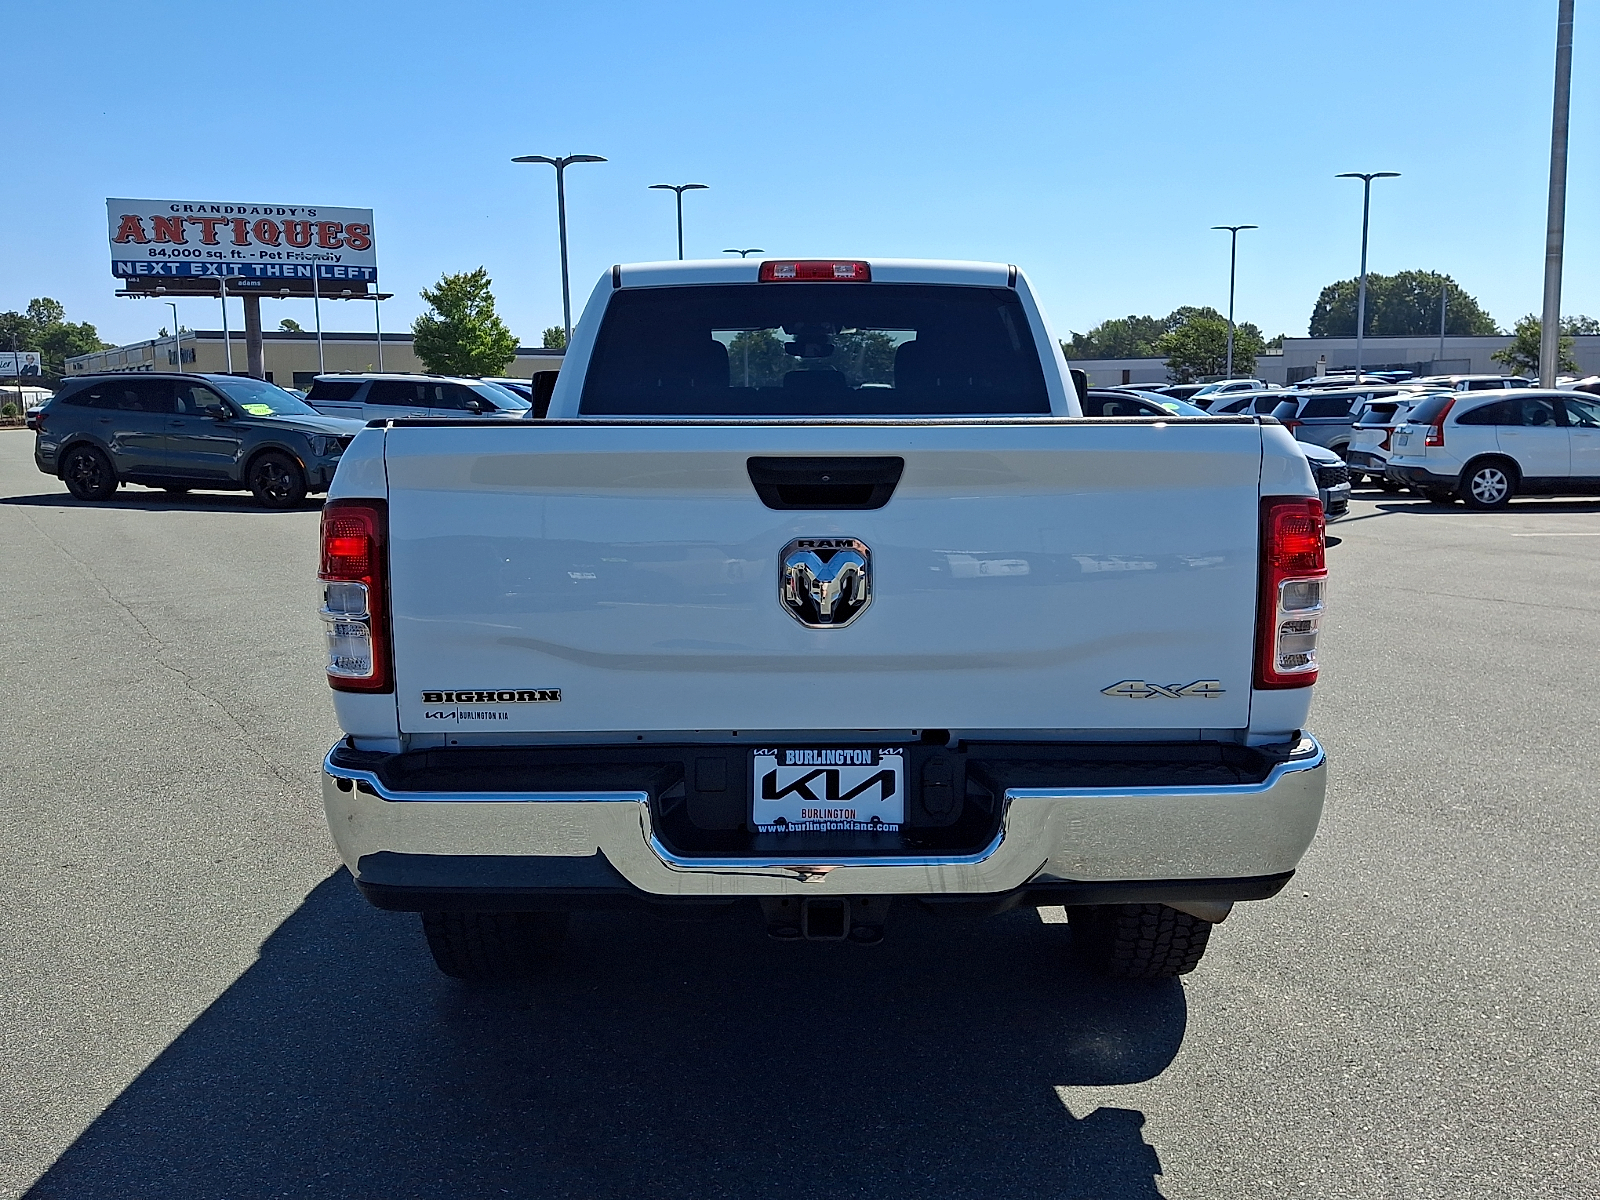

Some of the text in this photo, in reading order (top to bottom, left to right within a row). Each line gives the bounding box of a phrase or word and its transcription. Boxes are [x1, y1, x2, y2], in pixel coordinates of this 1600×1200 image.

[170, 204, 318, 217] GRANDDADDY'S
[112, 214, 372, 251] ANTIQUES
[148, 248, 202, 259] 84,000
[206, 250, 227, 261] sq.
[230, 250, 246, 259] ft.
[259, 250, 283, 260] Pet
[117, 261, 373, 280] NEXT EXIT THEN LEFT
[238, 279, 261, 287] adams
[798, 540, 854, 548] RAM
[422, 688, 561, 704] BIGHORN
[459, 711, 497, 720] BURLINGTON
[498, 711, 509, 720] KIA
[786, 749, 872, 765] BURLINGTON
[761, 768, 896, 802] KIA
[801, 808, 856, 820] BURLINGTON
[758, 821, 899, 833] www.burlingtonkianc.com
